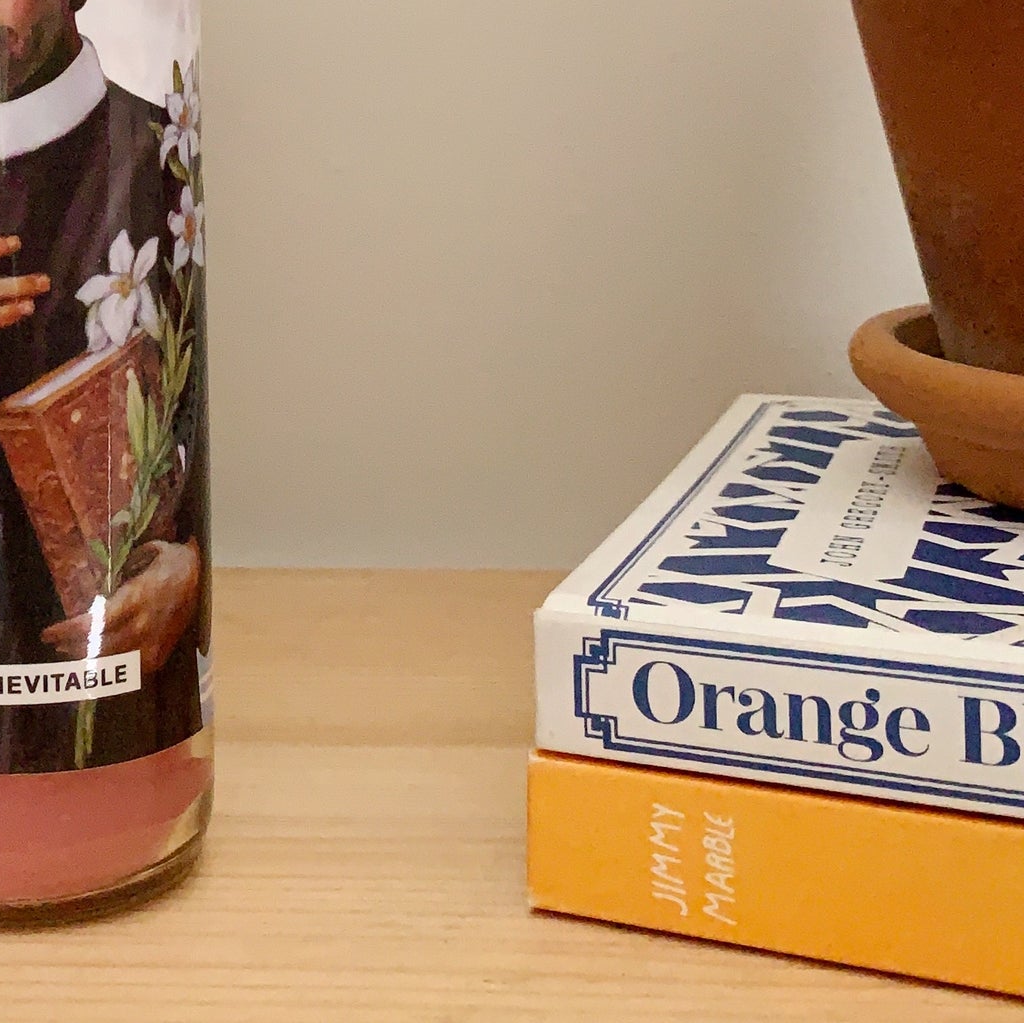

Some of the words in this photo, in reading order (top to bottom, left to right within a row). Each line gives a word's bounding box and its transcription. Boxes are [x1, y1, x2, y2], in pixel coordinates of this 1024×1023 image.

[820, 534, 865, 568] JOHN
[631, 660, 932, 763] Orange
[957, 694, 1024, 768] B
[648, 801, 689, 917] JIMMY
[701, 810, 738, 926] MARBLE
